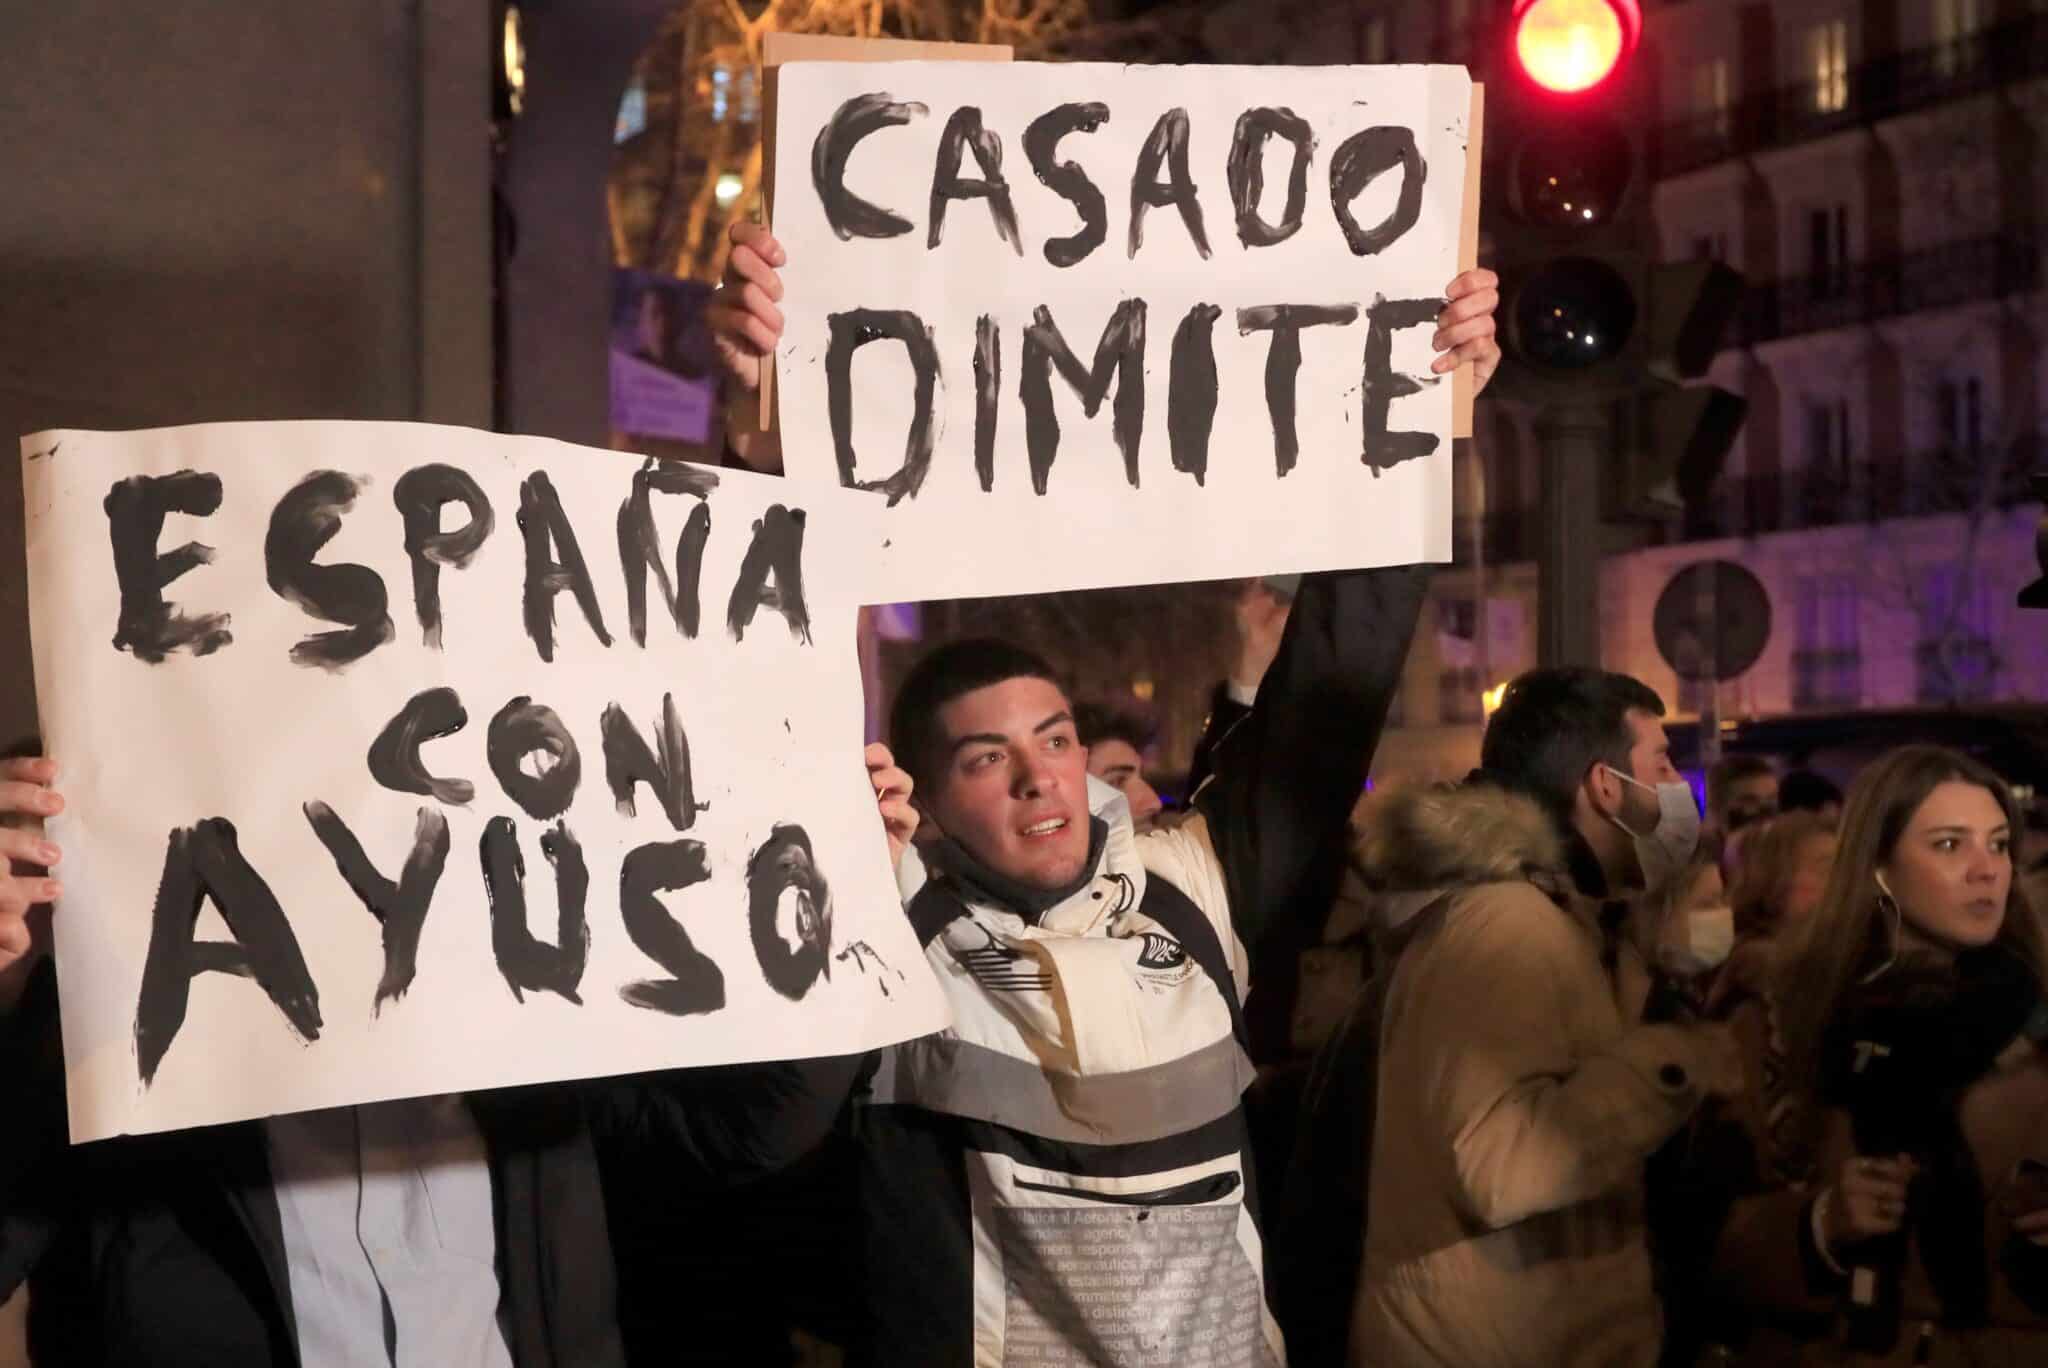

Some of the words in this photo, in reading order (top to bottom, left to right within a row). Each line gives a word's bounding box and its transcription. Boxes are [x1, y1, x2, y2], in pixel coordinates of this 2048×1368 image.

[811, 92, 1428, 268] CASADO
[825, 294, 1452, 507] DIMITE
[104, 457, 813, 673] ESPAÑA
[367, 687, 711, 831] CON
[135, 802, 833, 1090] AYUSO
